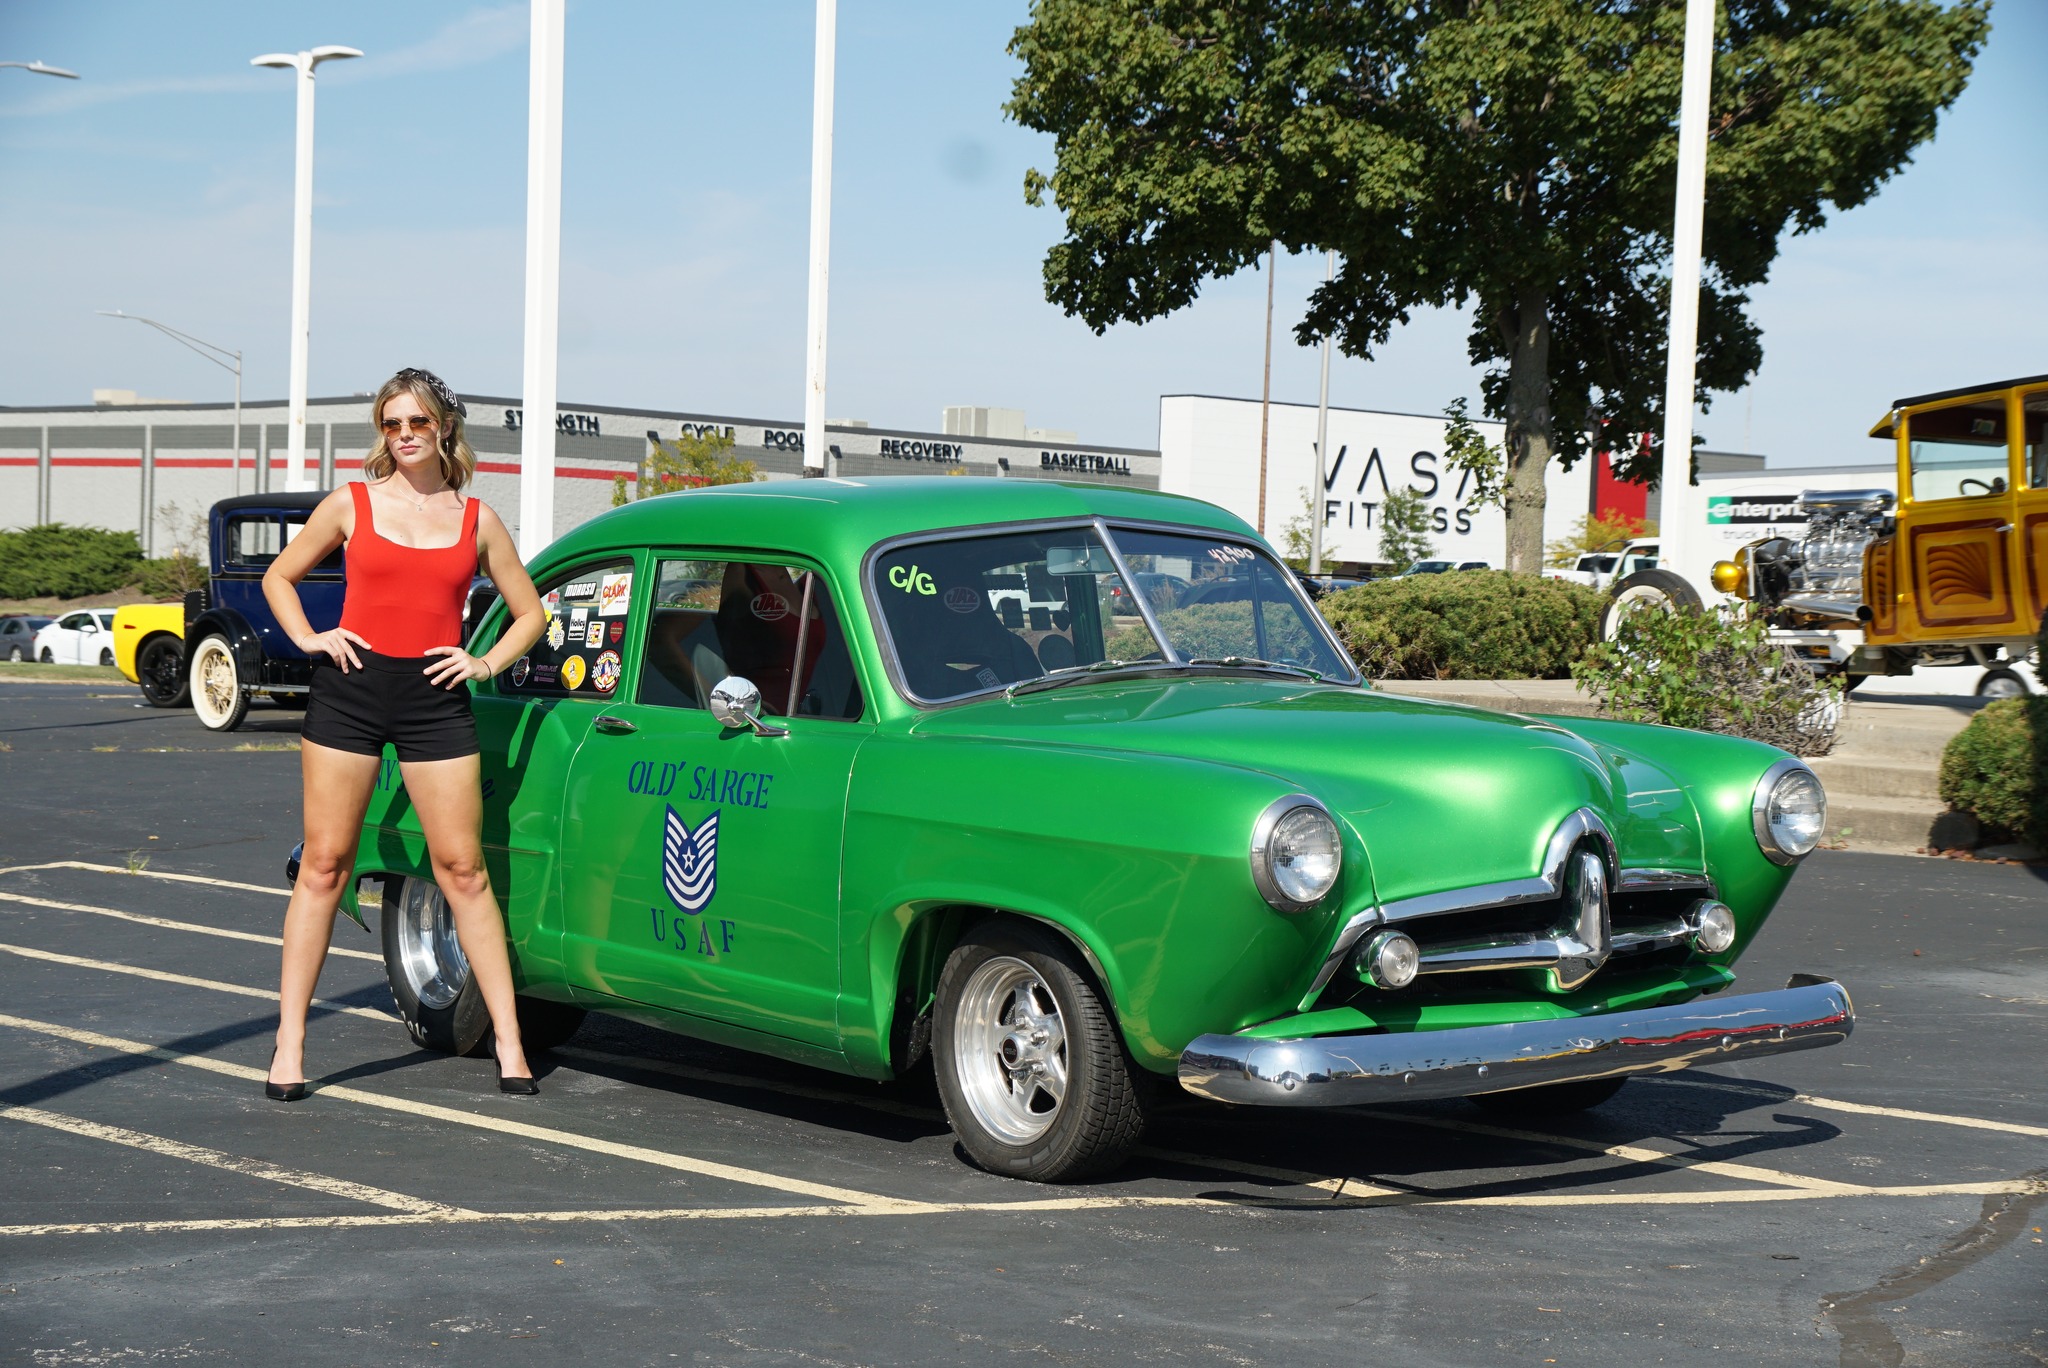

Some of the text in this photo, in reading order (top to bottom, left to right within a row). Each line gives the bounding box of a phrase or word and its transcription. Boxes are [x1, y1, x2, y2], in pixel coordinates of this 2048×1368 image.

[505, 410, 598, 431] STNGTH
[881, 439, 962, 458] RECOVERY
[1041, 452, 1130, 470] BASKETBALL
[1326, 500, 1471, 533] FITSS
[1711, 502, 1808, 520] enterpri
[889, 565, 937, 595] C/G
[565, 583, 596, 597] MOROSO
[603, 584, 626, 598] CLARK
[689, 766, 773, 809] SARGE
